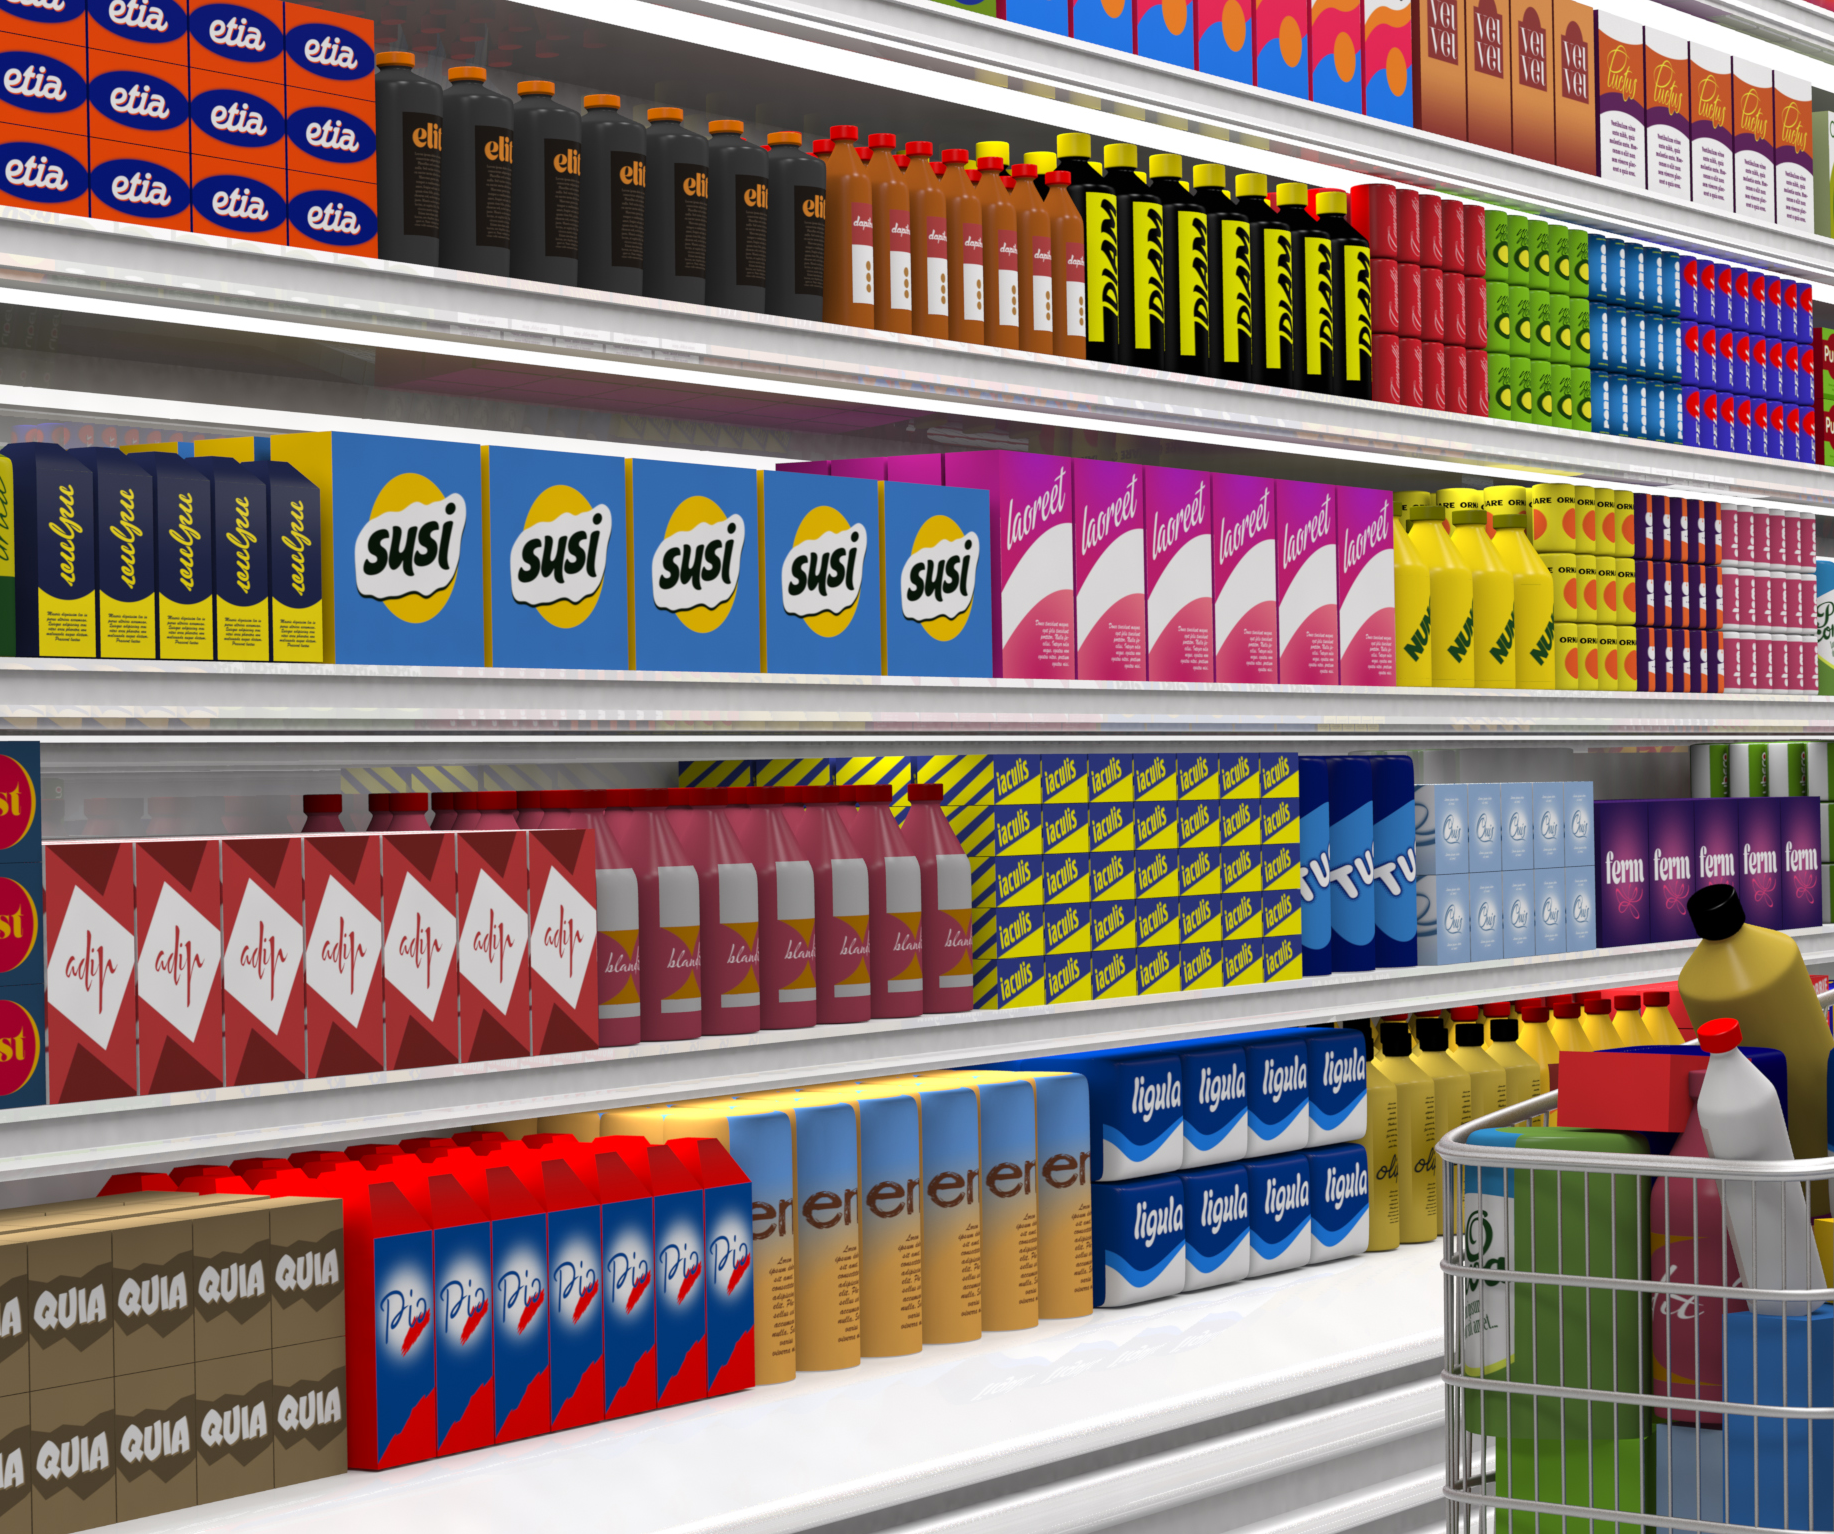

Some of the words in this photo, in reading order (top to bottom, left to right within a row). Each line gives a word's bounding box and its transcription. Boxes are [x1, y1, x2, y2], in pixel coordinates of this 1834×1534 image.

[208, 16, 265, 55] etia
[1007, 466, 1067, 552] laoreet
[1081, 475, 1138, 556] laoreet
[1152, 484, 1206, 561] laoreet
[364, 502, 456, 576] susi
[518, 512, 603, 583] susi
[659, 522, 736, 590] susi
[995, 758, 1030, 796] iaculis
[1044, 757, 1077, 795] iaculis
[1605, 851, 1645, 885] ferm
[1653, 848, 1691, 882] ferm
[1131, 1073, 1181, 1123] ligula
[1198, 1064, 1246, 1114] ligula
[32, 1281, 107, 1332] QUIA
[117, 1270, 188, 1319] QUIA
